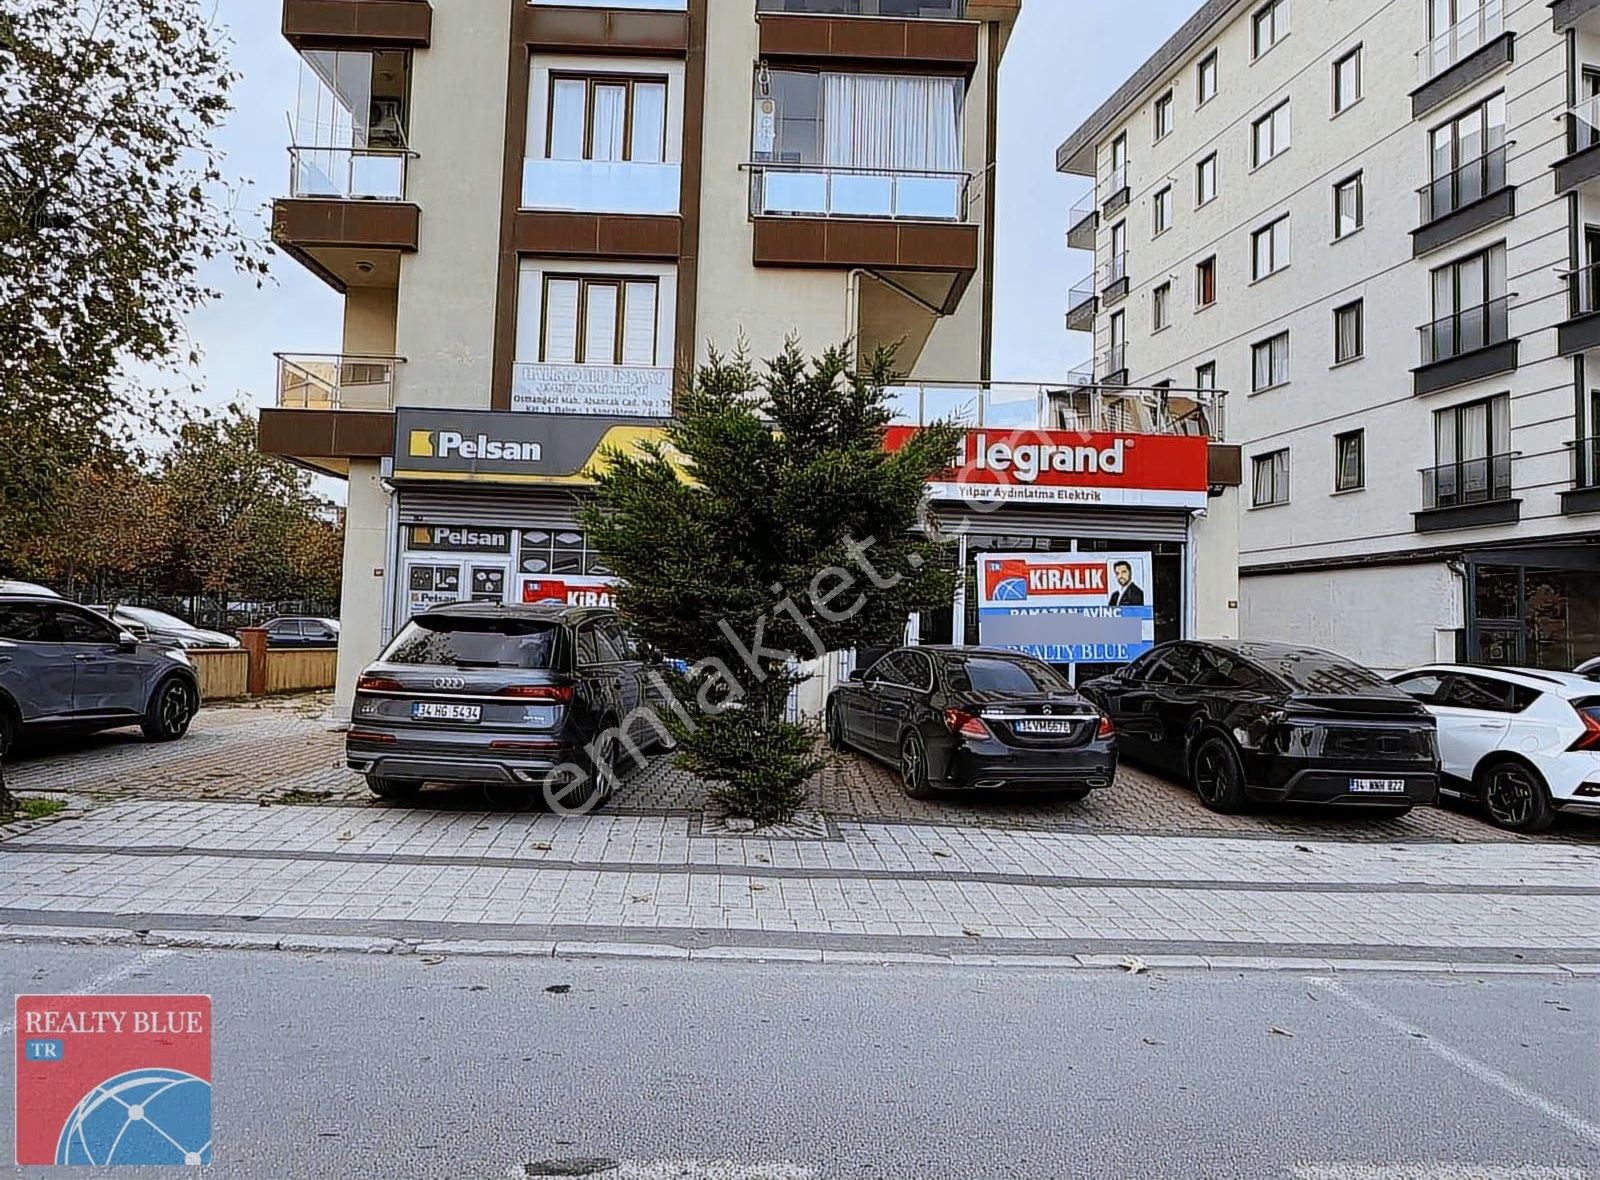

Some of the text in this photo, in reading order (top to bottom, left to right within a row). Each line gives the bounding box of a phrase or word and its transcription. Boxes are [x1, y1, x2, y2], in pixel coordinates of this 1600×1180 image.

[438, 431, 542, 461] Pelsan
[976, 433, 1124, 483] legrand
[994, 488, 1055, 500] Aydınlatma
[1057, 490, 1101, 501] Elektrik
[433, 527, 506, 546] Pelsan
[1081, 644, 1129, 660] BLUE
[420, 704, 479, 718] 34 HG 5434
